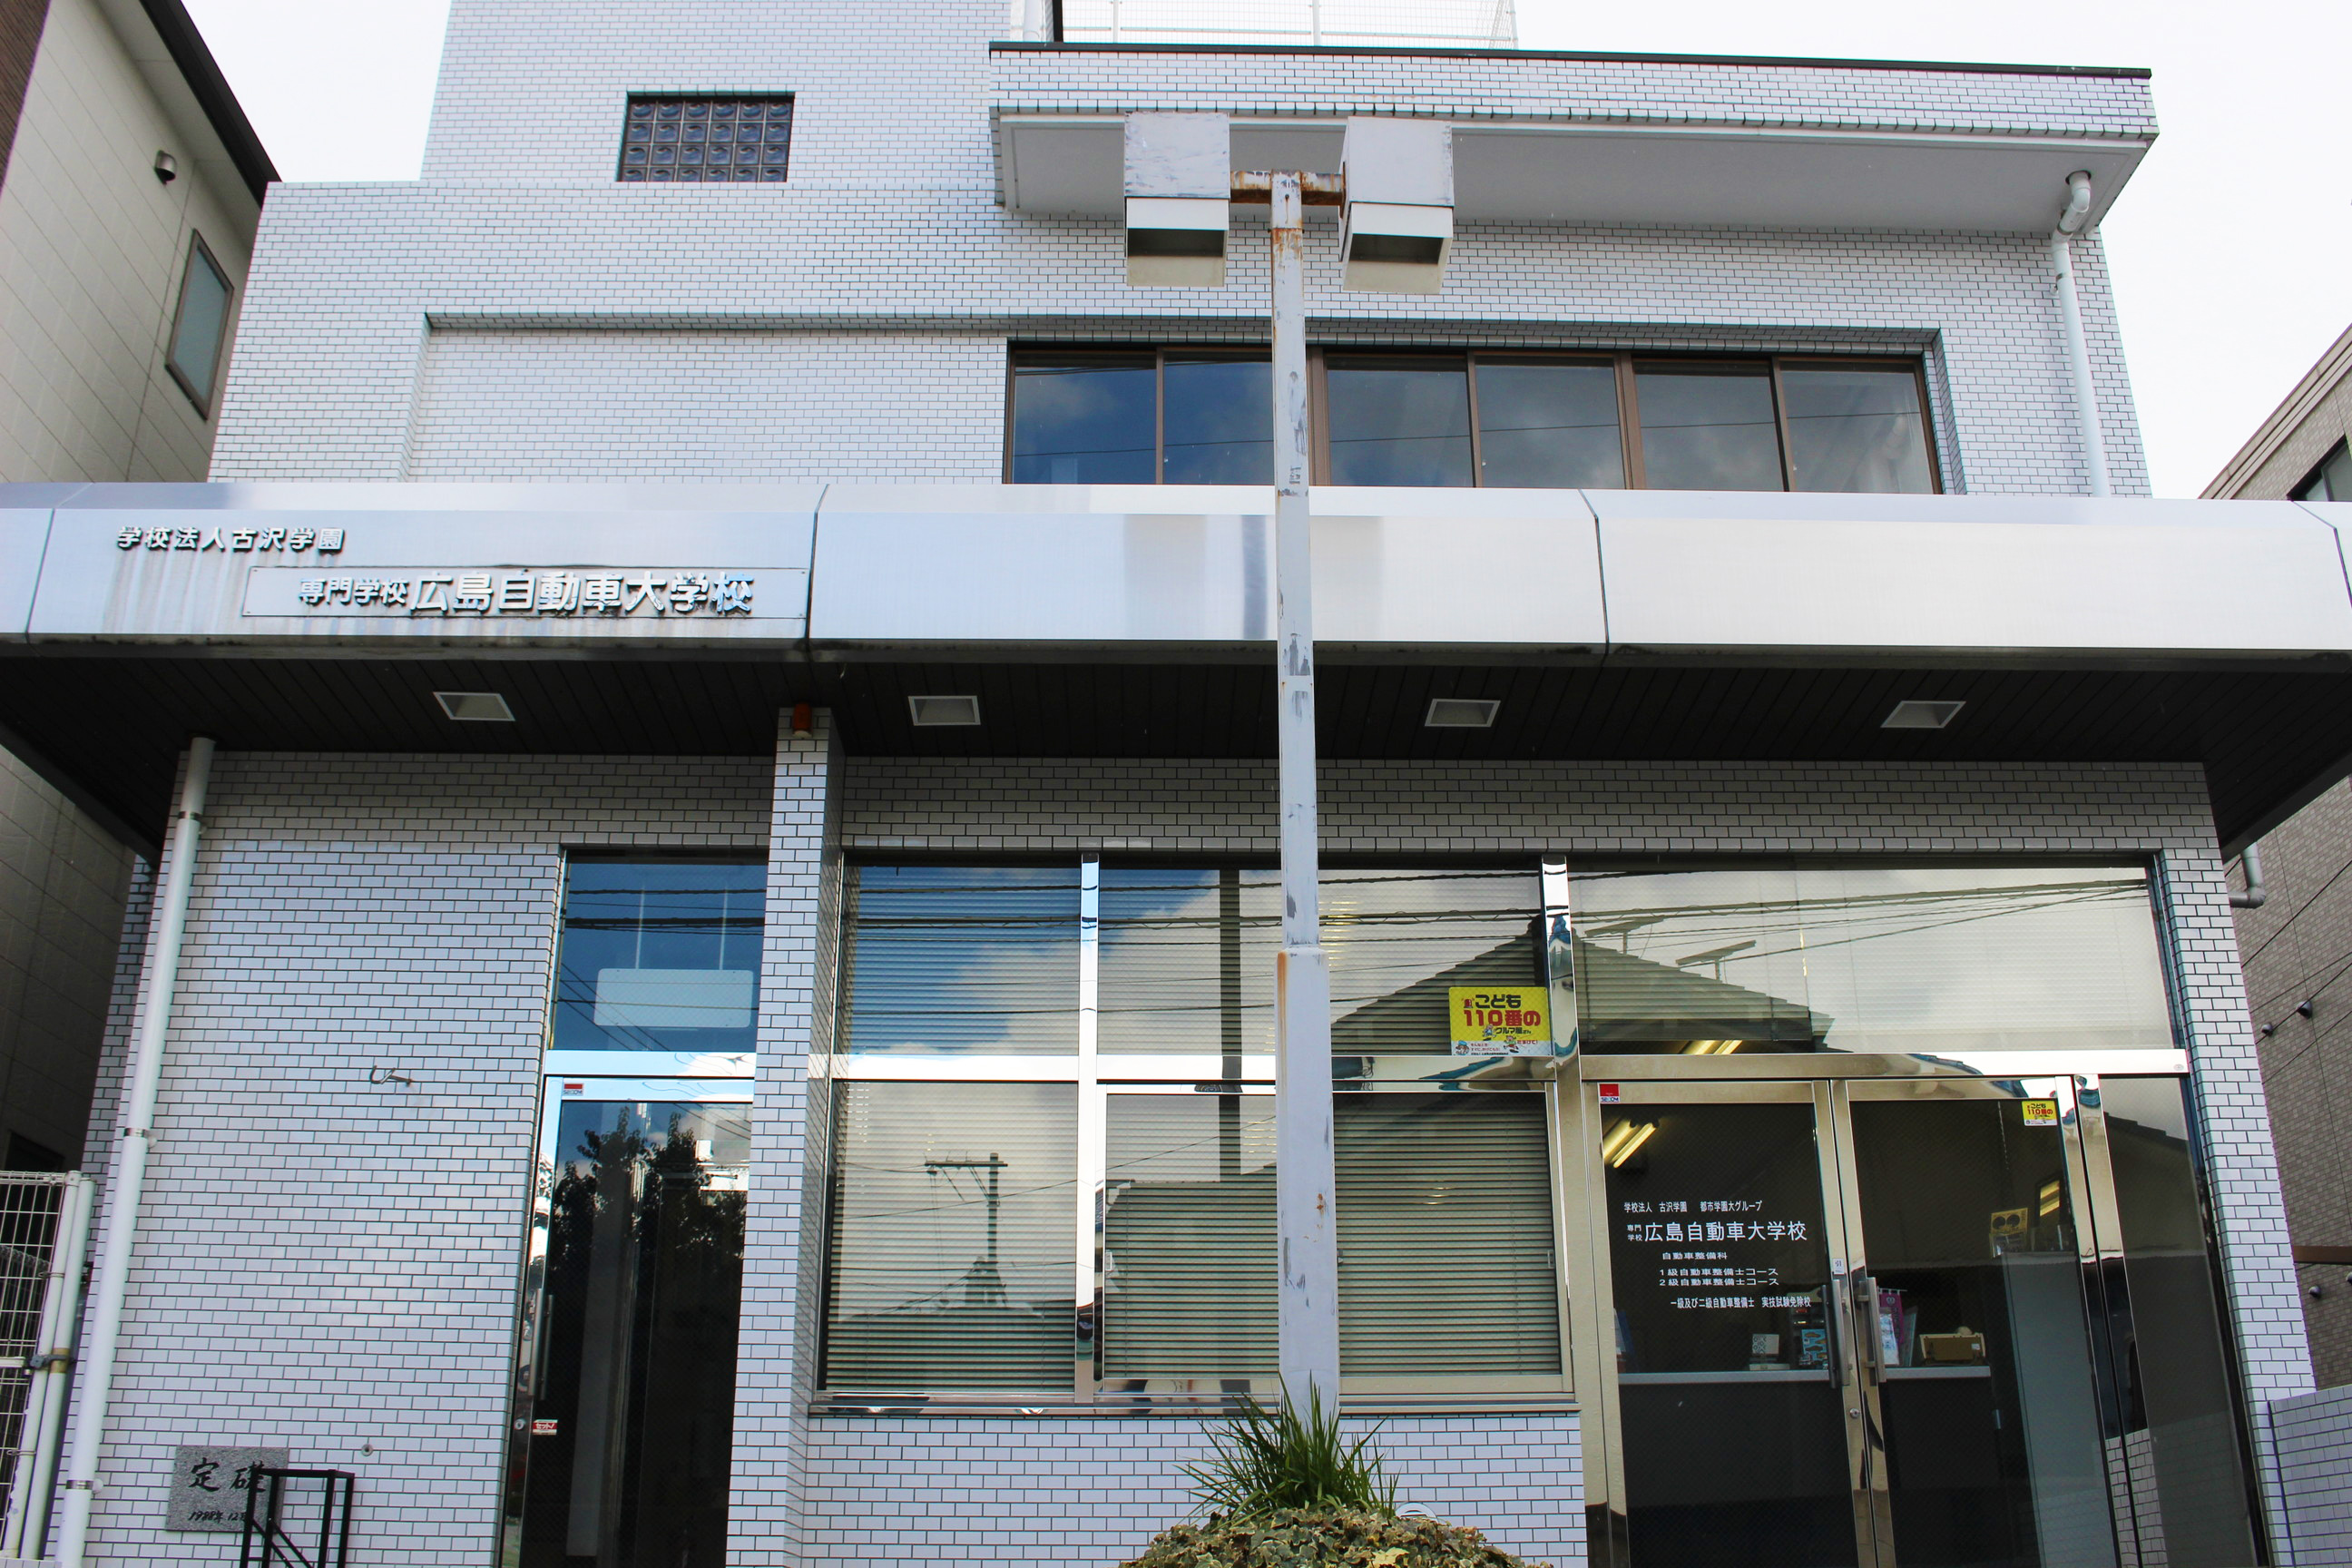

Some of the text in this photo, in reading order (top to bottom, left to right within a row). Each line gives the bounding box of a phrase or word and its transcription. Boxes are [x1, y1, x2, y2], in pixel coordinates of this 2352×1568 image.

[117, 527, 345, 552] 学校法人古沢学園
[299, 570, 755, 613] 専門学校広島自動車大学校
[1475, 995, 1521, 1008] こども
[1464, 1010, 1541, 1026] 110番の
[1624, 1200, 1762, 1212] 学校法人 古沢学園 都市学園大グループ
[1645, 1221, 1807, 1241] 広島自動車大学校
